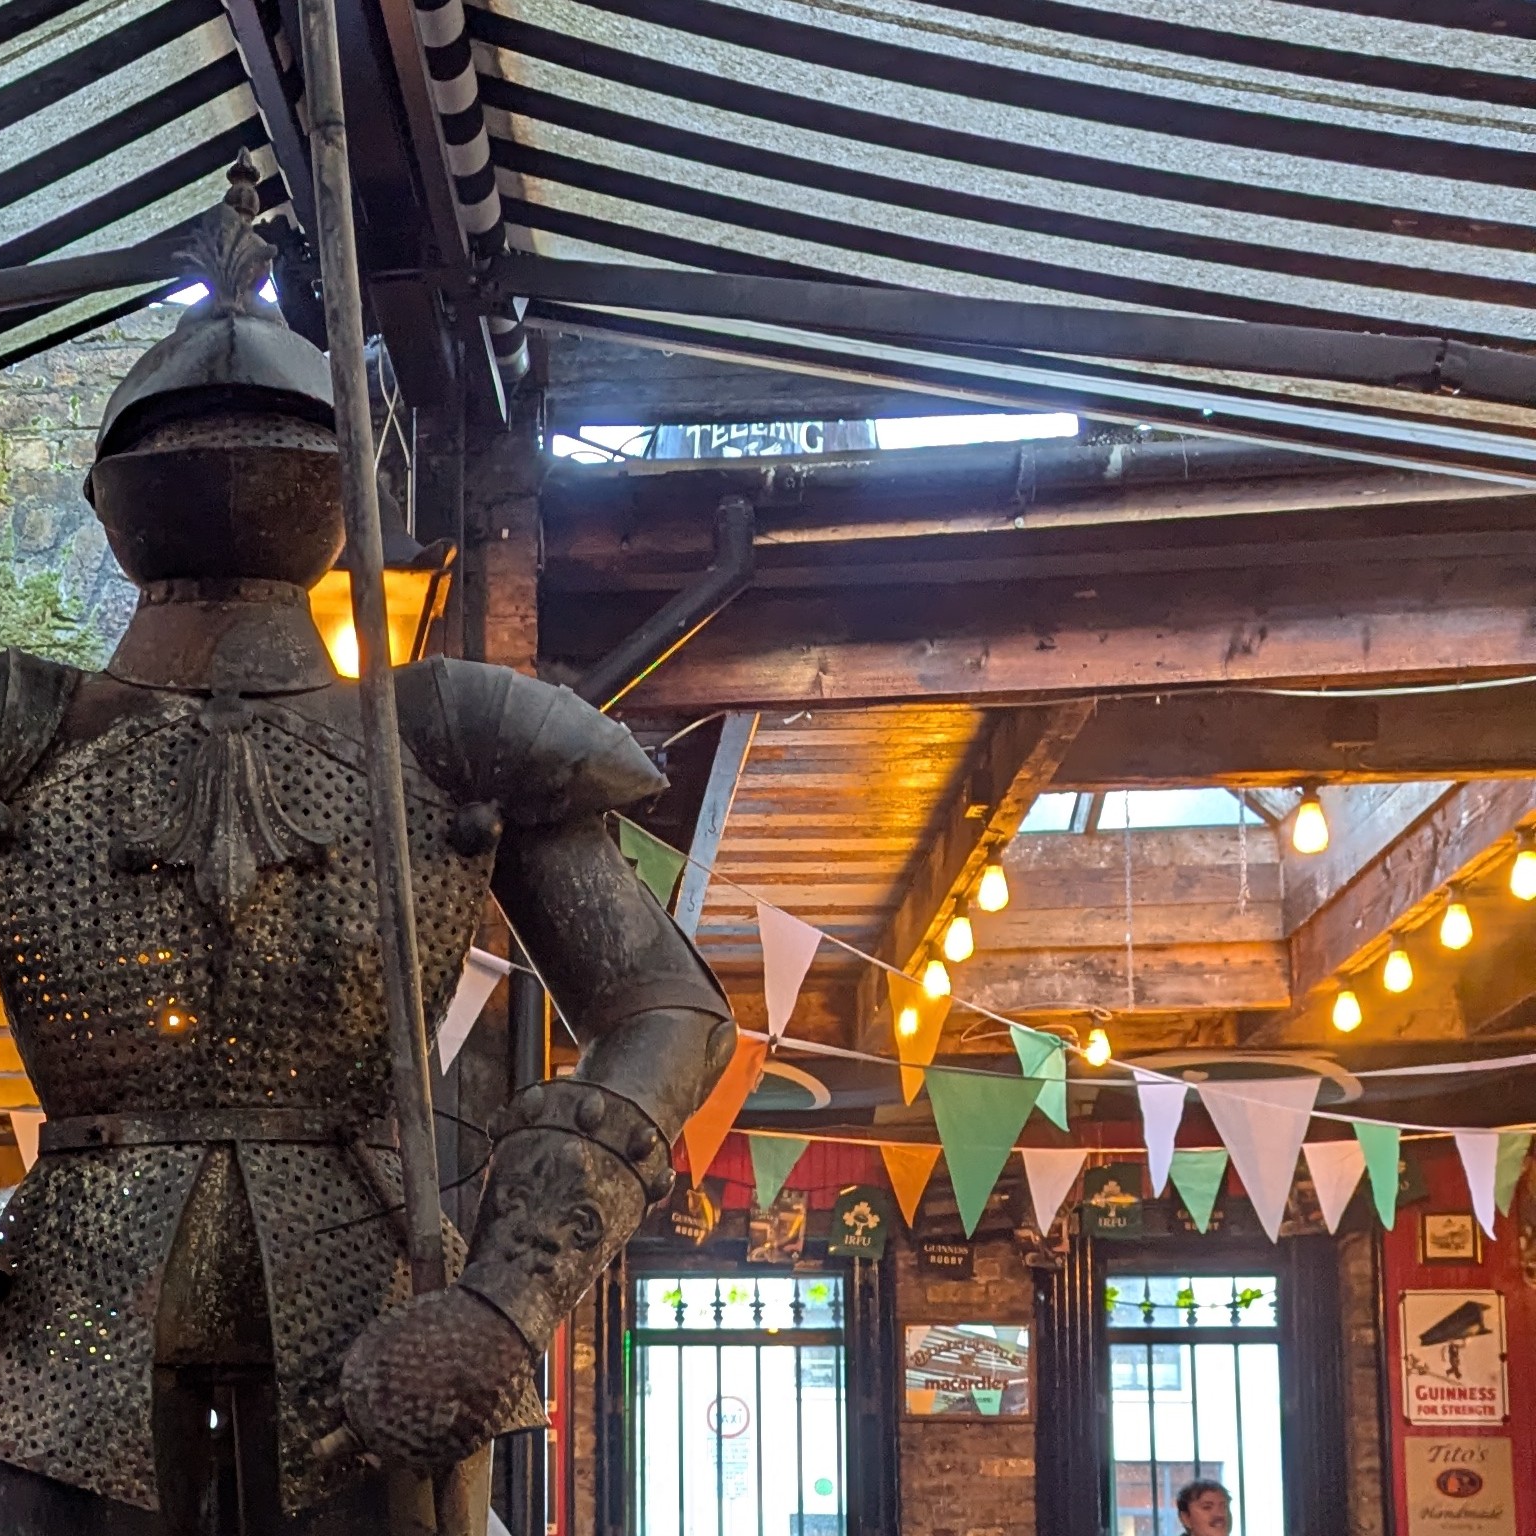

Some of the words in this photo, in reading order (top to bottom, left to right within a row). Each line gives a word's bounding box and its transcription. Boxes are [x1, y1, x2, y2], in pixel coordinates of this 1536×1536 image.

[1415, 1385, 1497, 1401] GUINNESS
[1417, 1405, 1439, 1416] FOR
[1441, 1405, 1496, 1416] STRENGTH
[1428, 1443, 1490, 1463] Tito's
